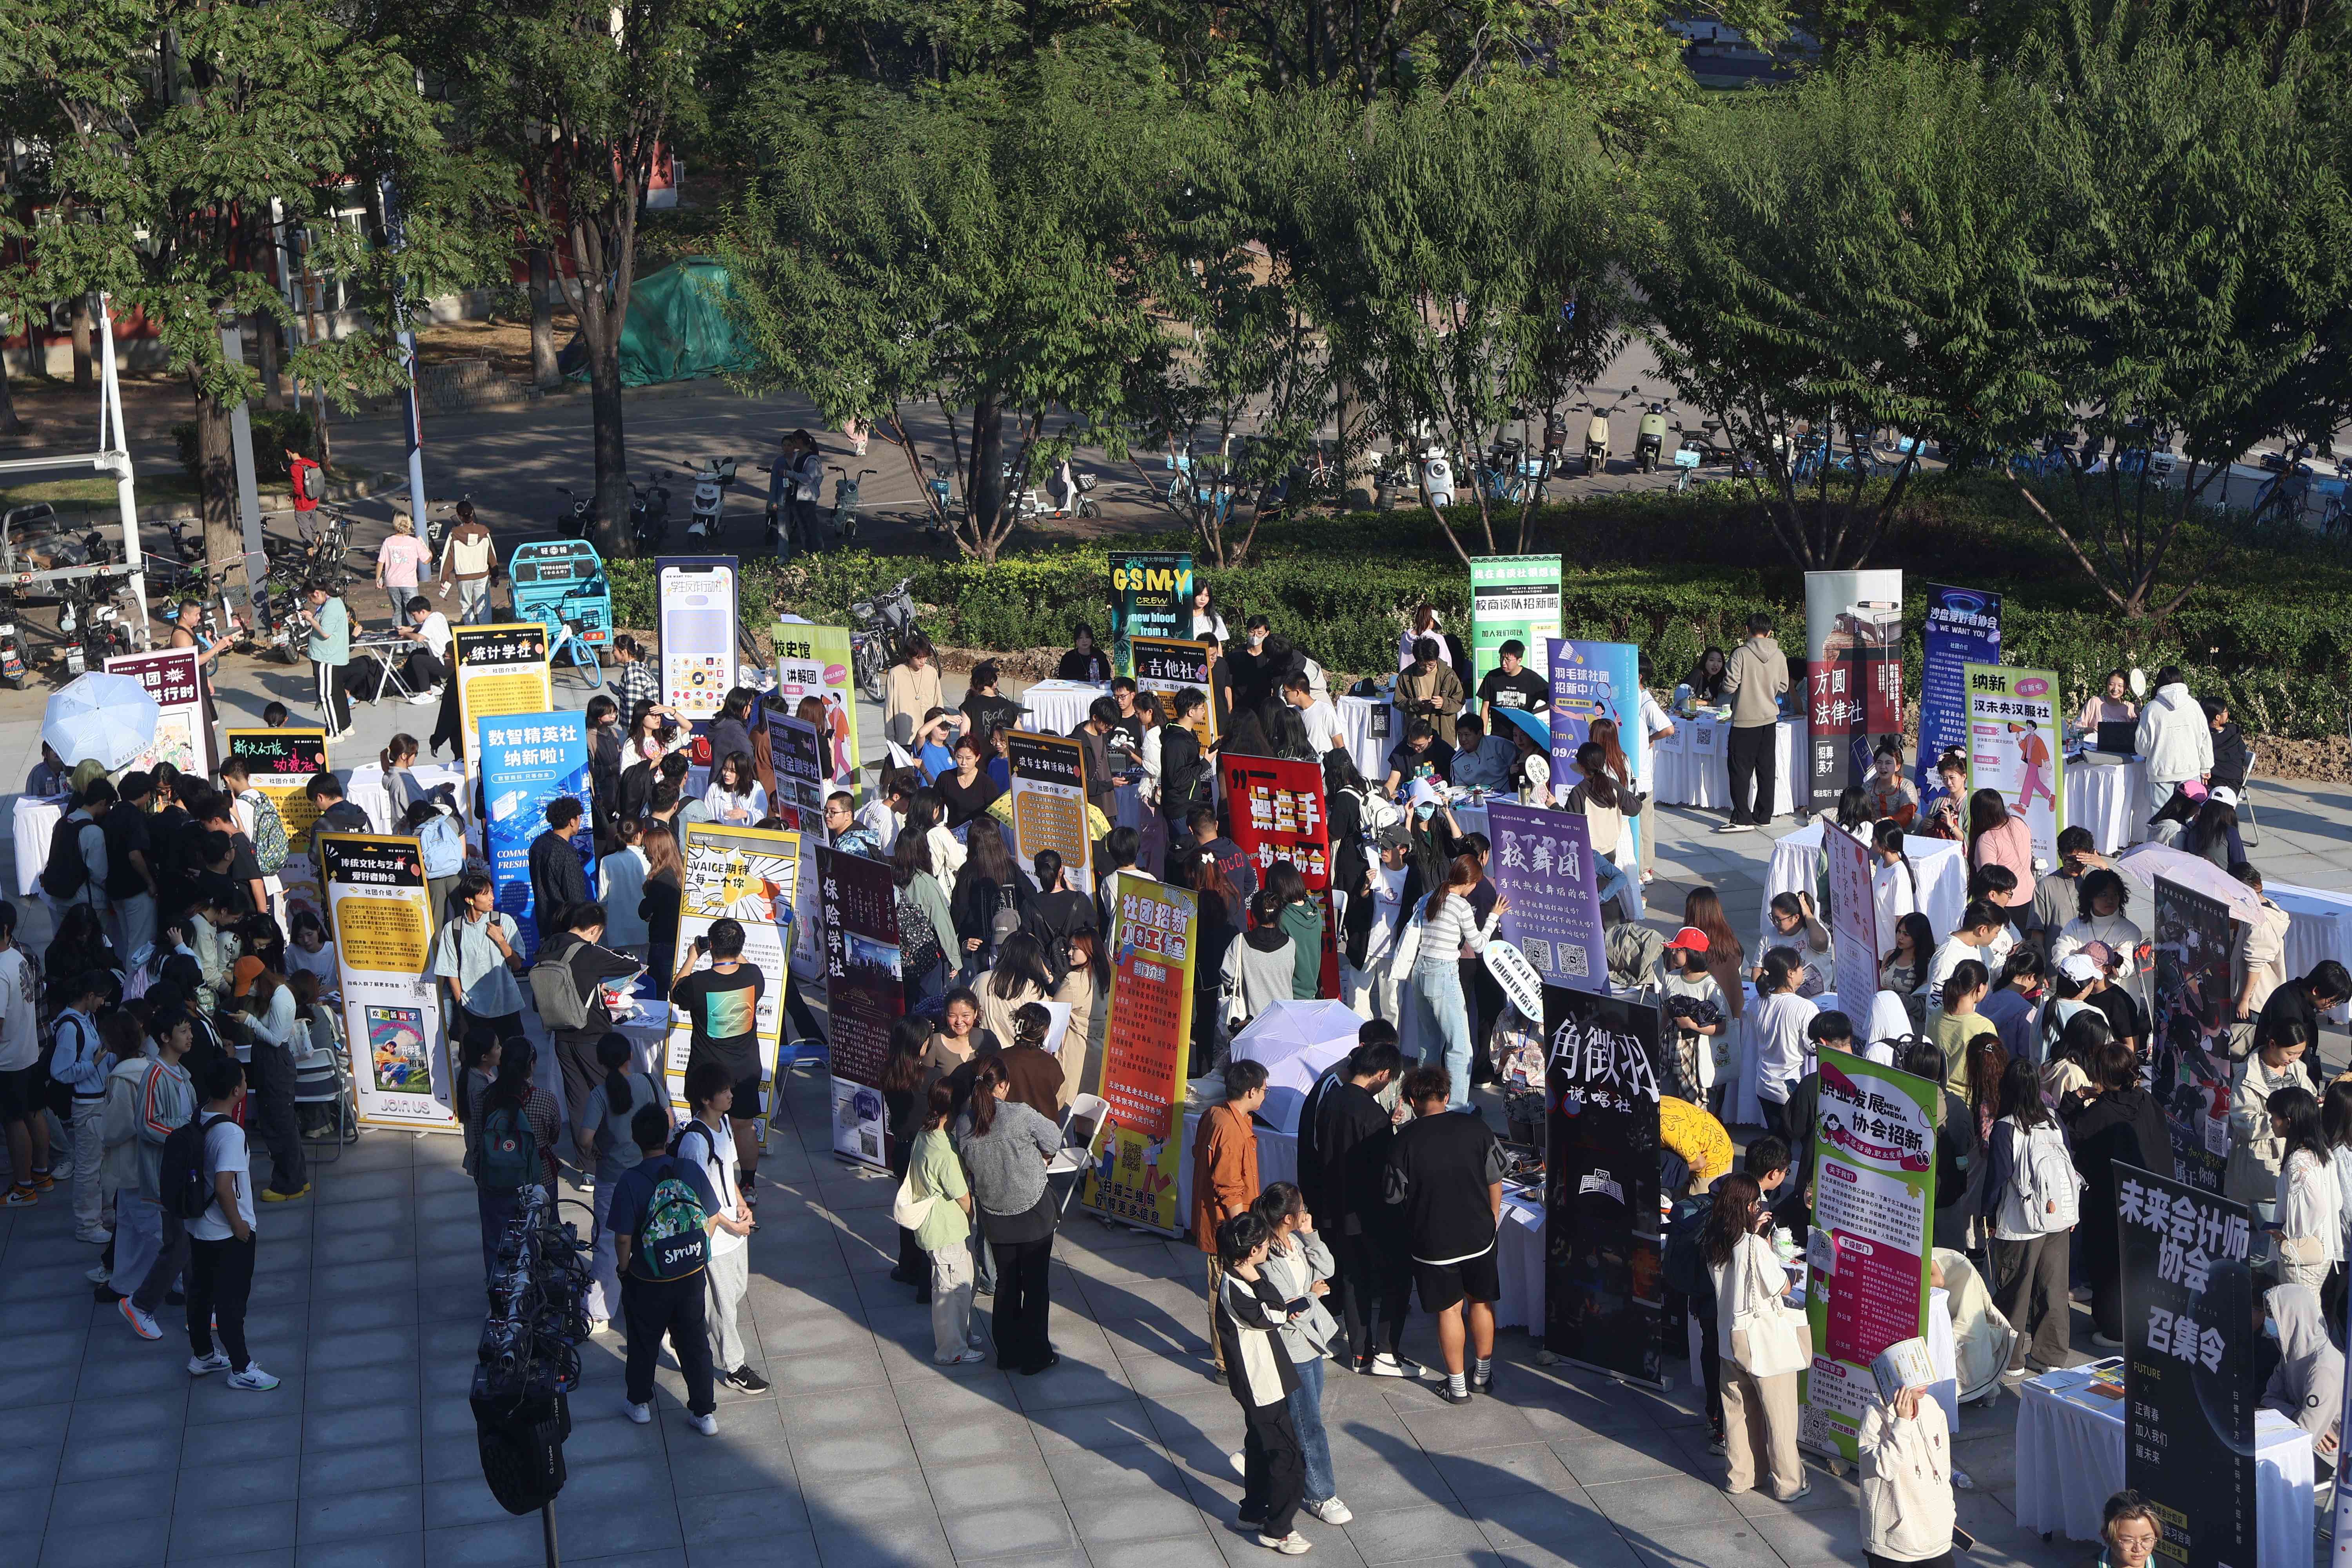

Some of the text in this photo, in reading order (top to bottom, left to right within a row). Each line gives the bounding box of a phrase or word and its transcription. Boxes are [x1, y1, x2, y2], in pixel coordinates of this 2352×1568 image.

[1113, 568, 1192, 593] GSMY
[1474, 567, 1560, 579] 我在商谈社很想你
[670, 581, 723, 592] 学生反诈行动社
[1475, 597, 1559, 611] 校商谈队招新啦
[1131, 613, 1176, 623] new blood
[1929, 606, 1998, 629] 沙盘爱好者协会
[1140, 626, 1161, 636] from
[1482, 629, 1524, 637] 加入我们可以
[1940, 624, 1986, 638] WE WANT YOU
[471, 644, 531, 661] 统计学社
[774, 639, 811, 659] 校史馆
[1950, 642, 1969, 651] 社团介绍
[787, 668, 817, 684] 讲解团
[1148, 657, 1196, 680] 吉他社
[1554, 667, 1610, 683] 羽毛球社团
[1555, 681, 1594, 695] 招新中！
[1814, 668, 1846, 696] 方圆
[1972, 673, 2006, 693] 纳新
[2020, 683, 2043, 693] 招新啦
[1815, 699, 1864, 726] 法律社
[1974, 699, 2050, 718] 汉未央汉服社
[488, 725, 577, 746] 数智精英社
[769, 727, 788, 739] 社团招新
[1551, 731, 1574, 741] Time
[1976, 737, 2014, 745] 全体喜欢汉服文化的同
[771, 738, 796, 754] WELCOME
[1818, 746, 1834, 759] 招募
[504, 747, 565, 767] 纳新啦！
[773, 750, 820, 780] 家庭金融学社
[1019, 756, 1074, 774] 流年尘轩话剧社
[1818, 759, 1834, 773] 英才
[1038, 785, 1059, 794] 社团介绍
[1813, 789, 1832, 798] 明法笃行
[1249, 785, 1320, 835] 操盘手
[341, 858, 404, 870] 传统文化与艺术
[1258, 842, 1325, 876] 投资协会
[1499, 841, 1581, 882] 校舞团
[352, 871, 396, 883] 爱好者协会
[693, 861, 750, 876] VAICE期待
[695, 873, 744, 889] 每一个你
[1499, 878, 1589, 900] 寻找热爱舞蹈的你
[365, 888, 392, 897] 社团介绍
[1851, 869, 1860, 926] 招新啦
[885, 894, 894, 932] 关于我们
[1123, 893, 1189, 935] 社团招新
[824, 877, 845, 977] 保险学社
[1120, 920, 1187, 960] 小图工作室
[1133, 960, 1167, 983] 部门介绍
[1492, 957, 1541, 1017] 团团伴你行
[372, 1009, 417, 1020] 欢迎新同学
[401, 1045, 421, 1056] 开学季
[409, 1059, 426, 1069] 招募
[1546, 1018, 1661, 1103] 角徵羽
[1567, 1085, 1633, 1114] 说唱社
[1819, 1077, 1885, 1116] 职业发展
[1884, 1102, 1901, 1112] NEW
[1883, 1109, 1908, 1123] MEDIA
[1852, 1111, 1923, 1151] 协会招新
[1843, 1132, 1903, 1159] 志愿活动,职业发展
[1829, 1165, 1854, 1181] 关于我们
[1102, 1179, 1156, 1209] 扫描二维码
[1095, 1191, 1160, 1225] 了解更多信息
[2118, 1178, 2250, 1263] 未来会计师
[665, 1241, 702, 1264] Spring
[1843, 1238, 1869, 1254] 下设部门
[1840, 1252, 1857, 1263] 市场部
[2158, 1233, 2211, 1294] 协会
[1839, 1267, 1854, 1278] 宣传部
[1837, 1289, 1853, 1299] 学术部
[2171, 1294, 2187, 1305] our
[2192, 1303, 2218, 1318] cause
[1837, 1311, 1852, 1323] 办公室
[1835, 1339, 1851, 1350] 公关部
[2147, 1305, 2226, 1374] 召集令
[1816, 1359, 1843, 1376] 招新要求
[2133, 1361, 2161, 1380] FUTURE
[2134, 1401, 2159, 1422] 正青春
[1831, 1420, 1856, 1437] 欢迎进群
[2135, 1422, 2167, 1447] 加入我们
[1804, 1438, 1823, 1450] 扫码报名
[2135, 1443, 2160, 1465] 耀未来
